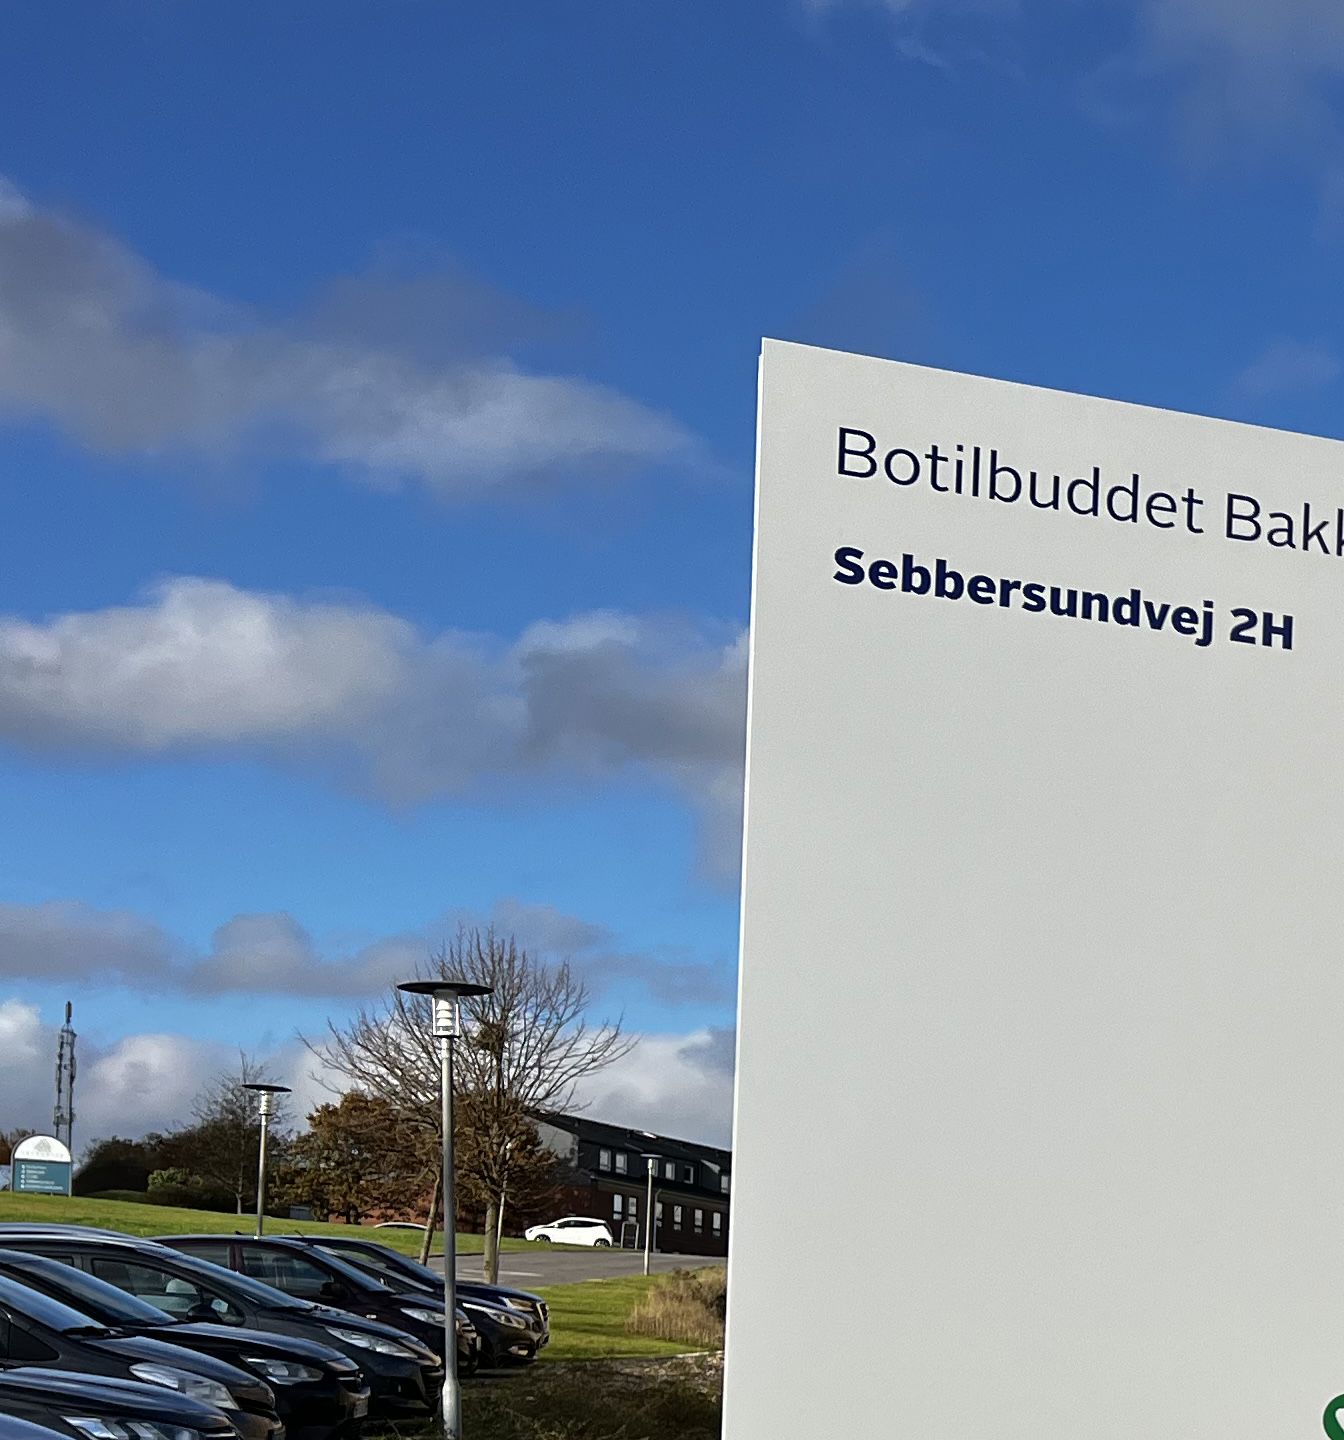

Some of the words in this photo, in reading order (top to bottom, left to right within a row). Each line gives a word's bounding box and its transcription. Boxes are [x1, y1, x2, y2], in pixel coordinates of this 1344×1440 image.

[838, 427, 1203, 533] Botilbuddet
[833, 547, 1213, 646] Sebbersundvej
[1230, 608, 1293, 650] 2H
